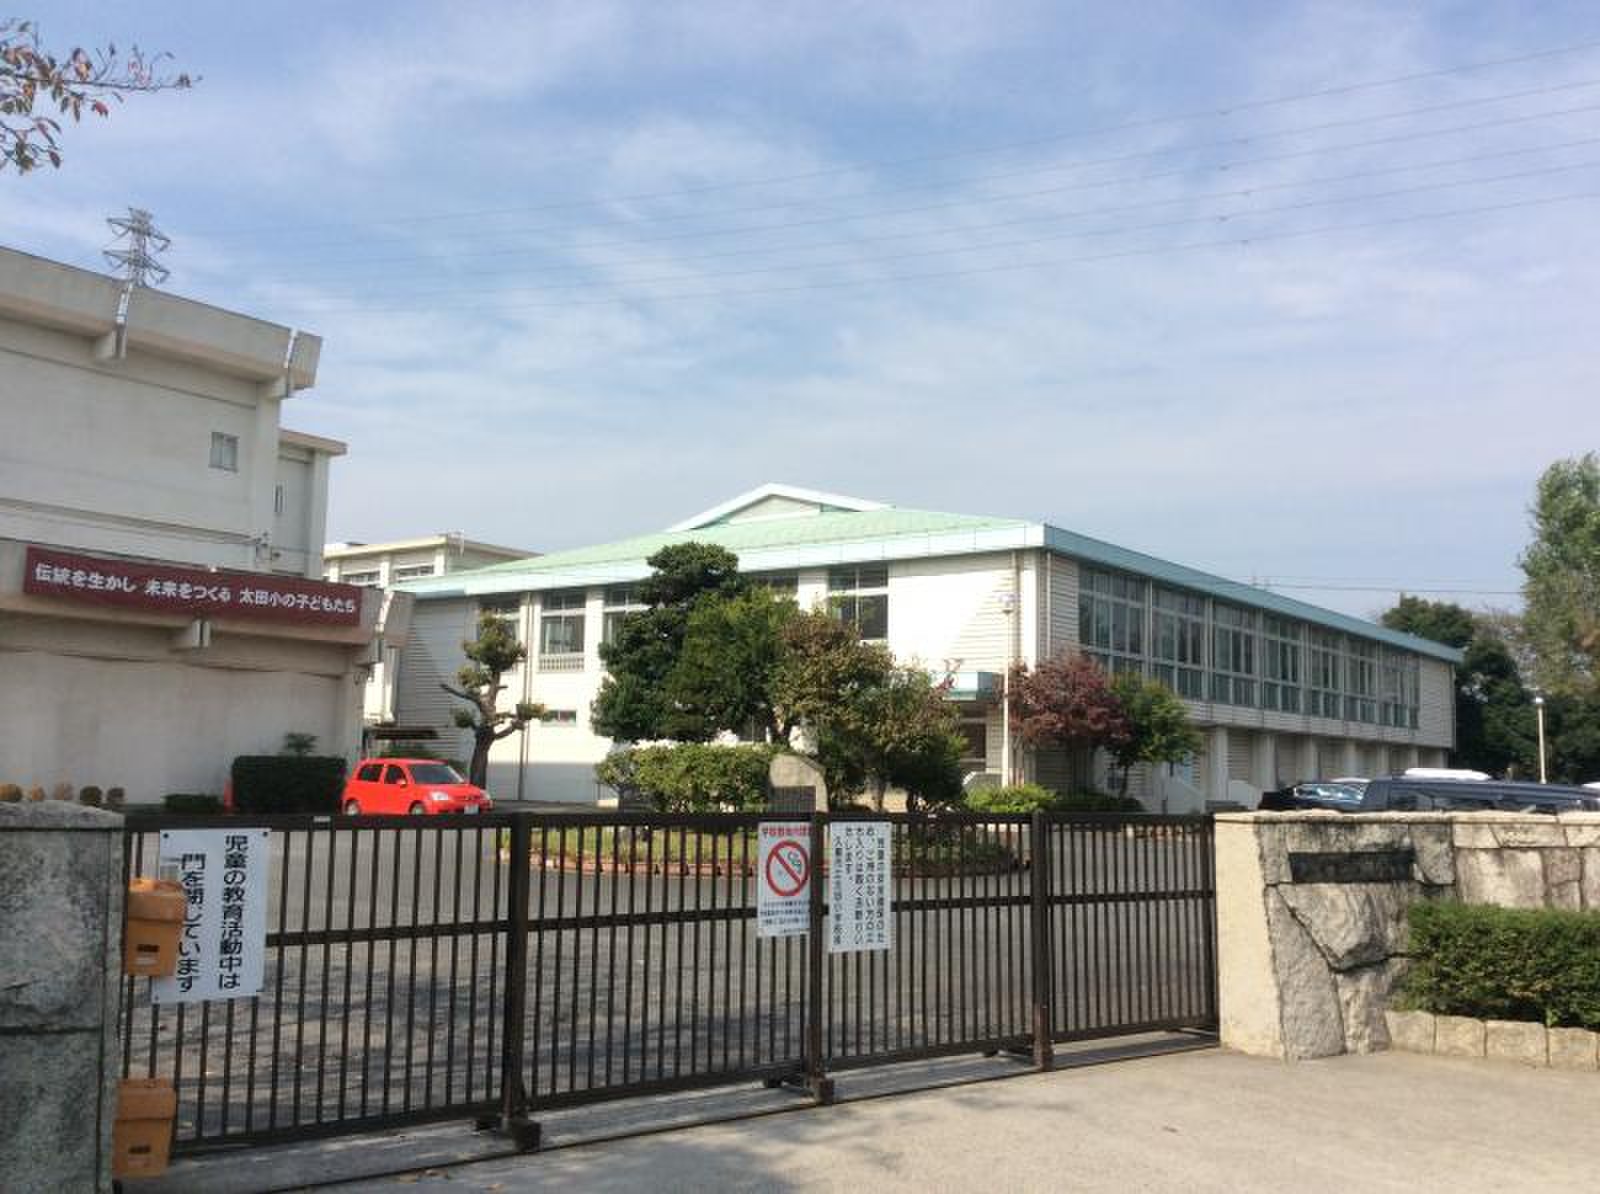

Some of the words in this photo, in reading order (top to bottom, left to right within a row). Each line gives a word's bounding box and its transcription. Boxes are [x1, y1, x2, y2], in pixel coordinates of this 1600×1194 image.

[34, 562, 138, 593] 伝統を生かし
[145, 578, 232, 602] 未来をつくる
[239, 586, 355, 613] 太田小の子どもたち
[218, 834, 250, 990] 児童の教育活動中は
